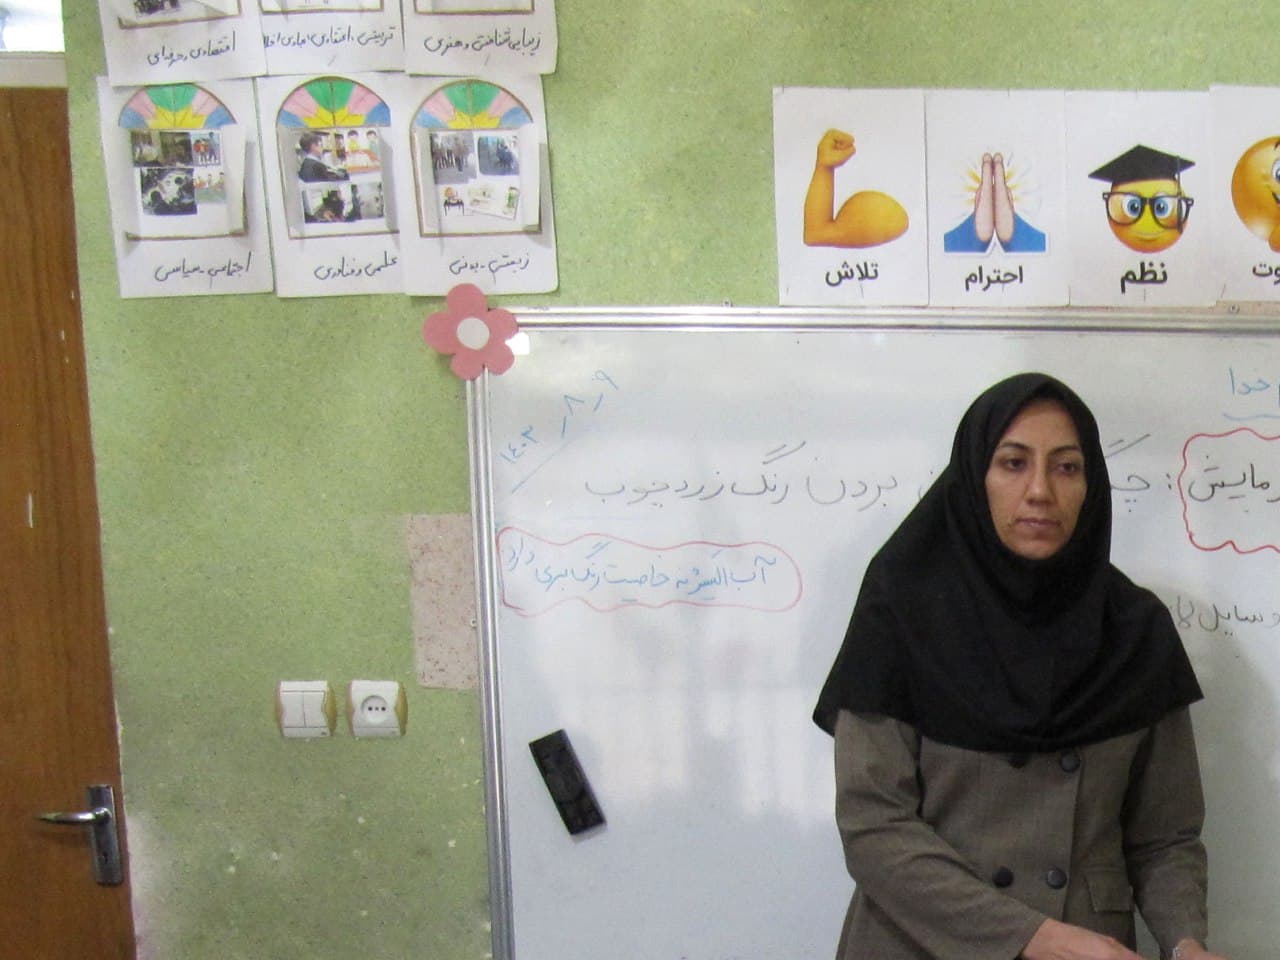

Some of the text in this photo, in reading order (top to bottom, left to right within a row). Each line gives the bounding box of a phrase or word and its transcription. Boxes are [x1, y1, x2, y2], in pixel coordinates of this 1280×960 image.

[365, 250, 398, 276] علمی
[825, 262, 879, 287] تلاش
[965, 265, 1024, 292] احترام
[1120, 261, 1168, 294] نظم
[1228, 366, 1270, 396] خدا
[731, 440, 807, 505] رنگ
[806, 457, 898, 513] بردن
[730, 555, 777, 591] آب
[1198, 603, 1280, 636] وسایل
